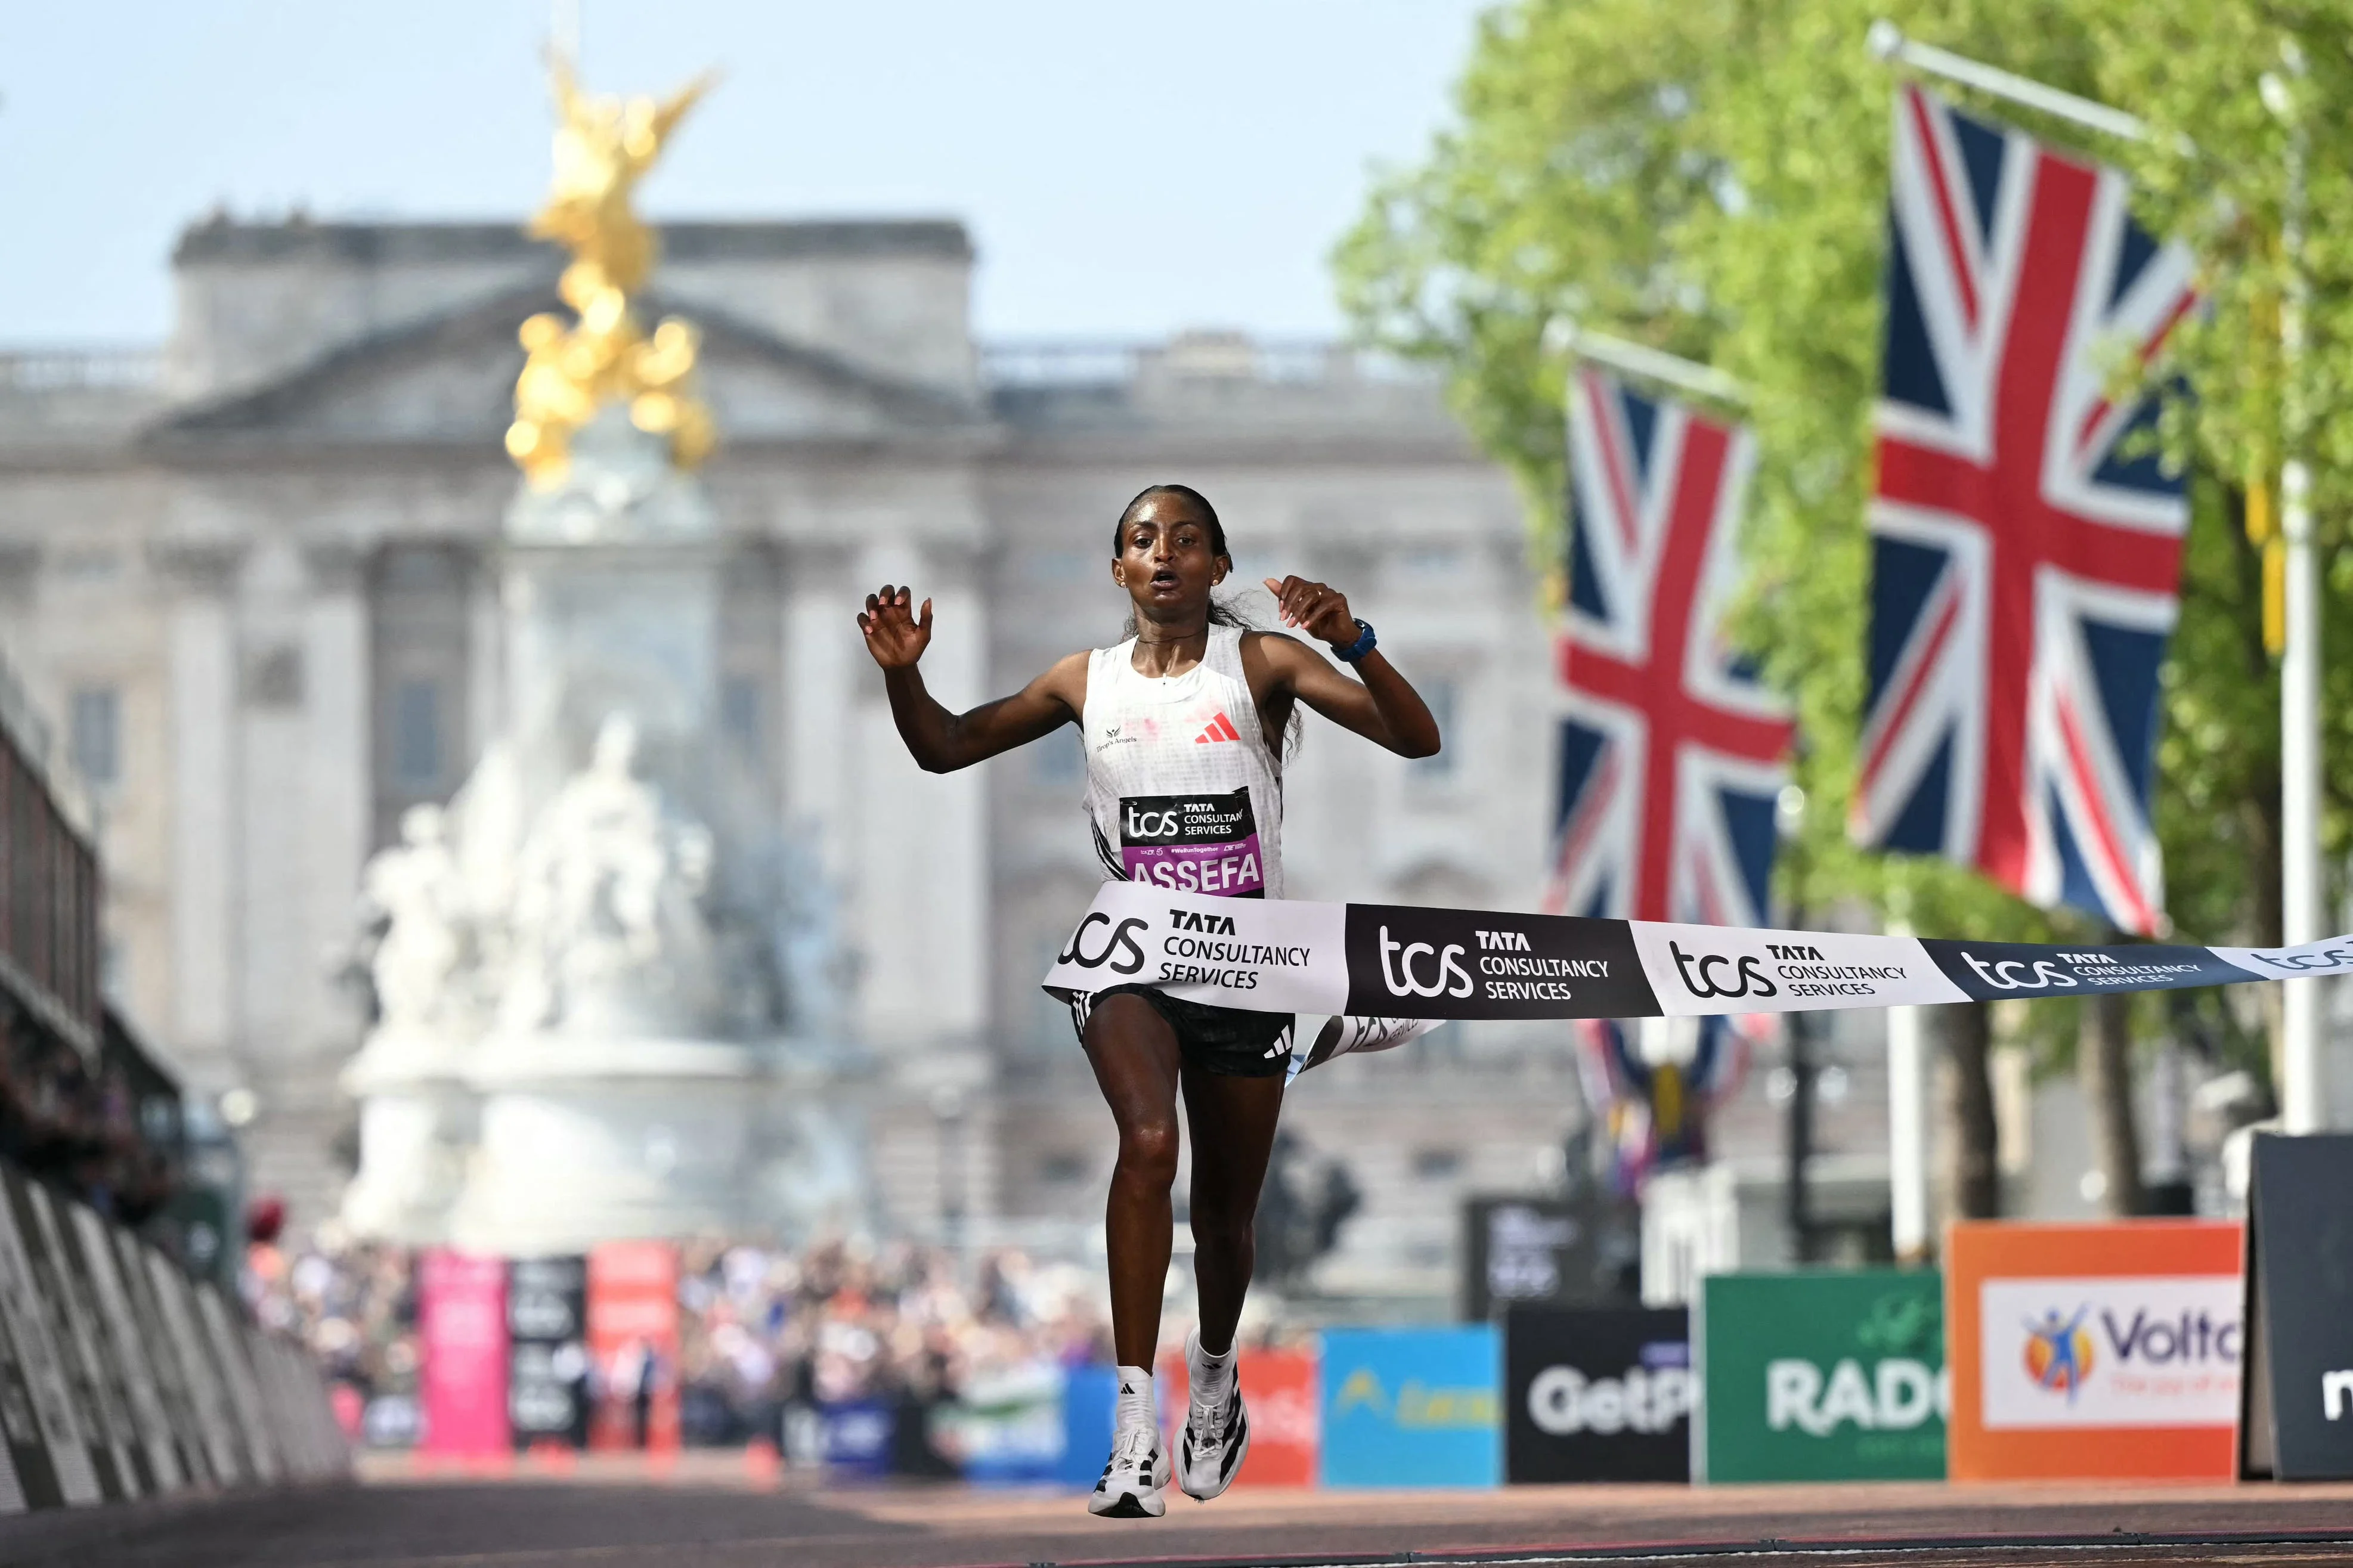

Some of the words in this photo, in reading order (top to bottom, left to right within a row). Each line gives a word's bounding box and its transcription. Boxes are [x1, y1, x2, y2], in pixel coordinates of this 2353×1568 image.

[1097, 740, 1113, 752] Tirop's
[1184, 803, 1215, 813] TATA
[1129, 806, 1178, 837] tcs
[1185, 825, 1232, 835] SERVICES
[1134, 853, 1259, 893] ASSEFA
[1169, 909, 1236, 936] TATA
[1057, 912, 1148, 975] cs
[1475, 931, 1531, 951] TATA
[1164, 937, 1310, 967] CONSULTANCY
[1379, 925, 1474, 998] tcs
[1766, 944, 1825, 960] TATA
[2056, 953, 2119, 964] TATA
[1158, 962, 1258, 990] SERVICES
[1479, 957, 1609, 978] CONSULTANCY
[1669, 940, 1777, 998] tcs
[1778, 966, 1908, 979] CONSULTANCY
[1961, 952, 2078, 989] tcs
[2073, 964, 2203, 977] CONSULTANCY
[1485, 981, 1571, 1000] SERVICES
[1788, 983, 1876, 997] SERVICES
[2087, 975, 2174, 986] SERVICES
